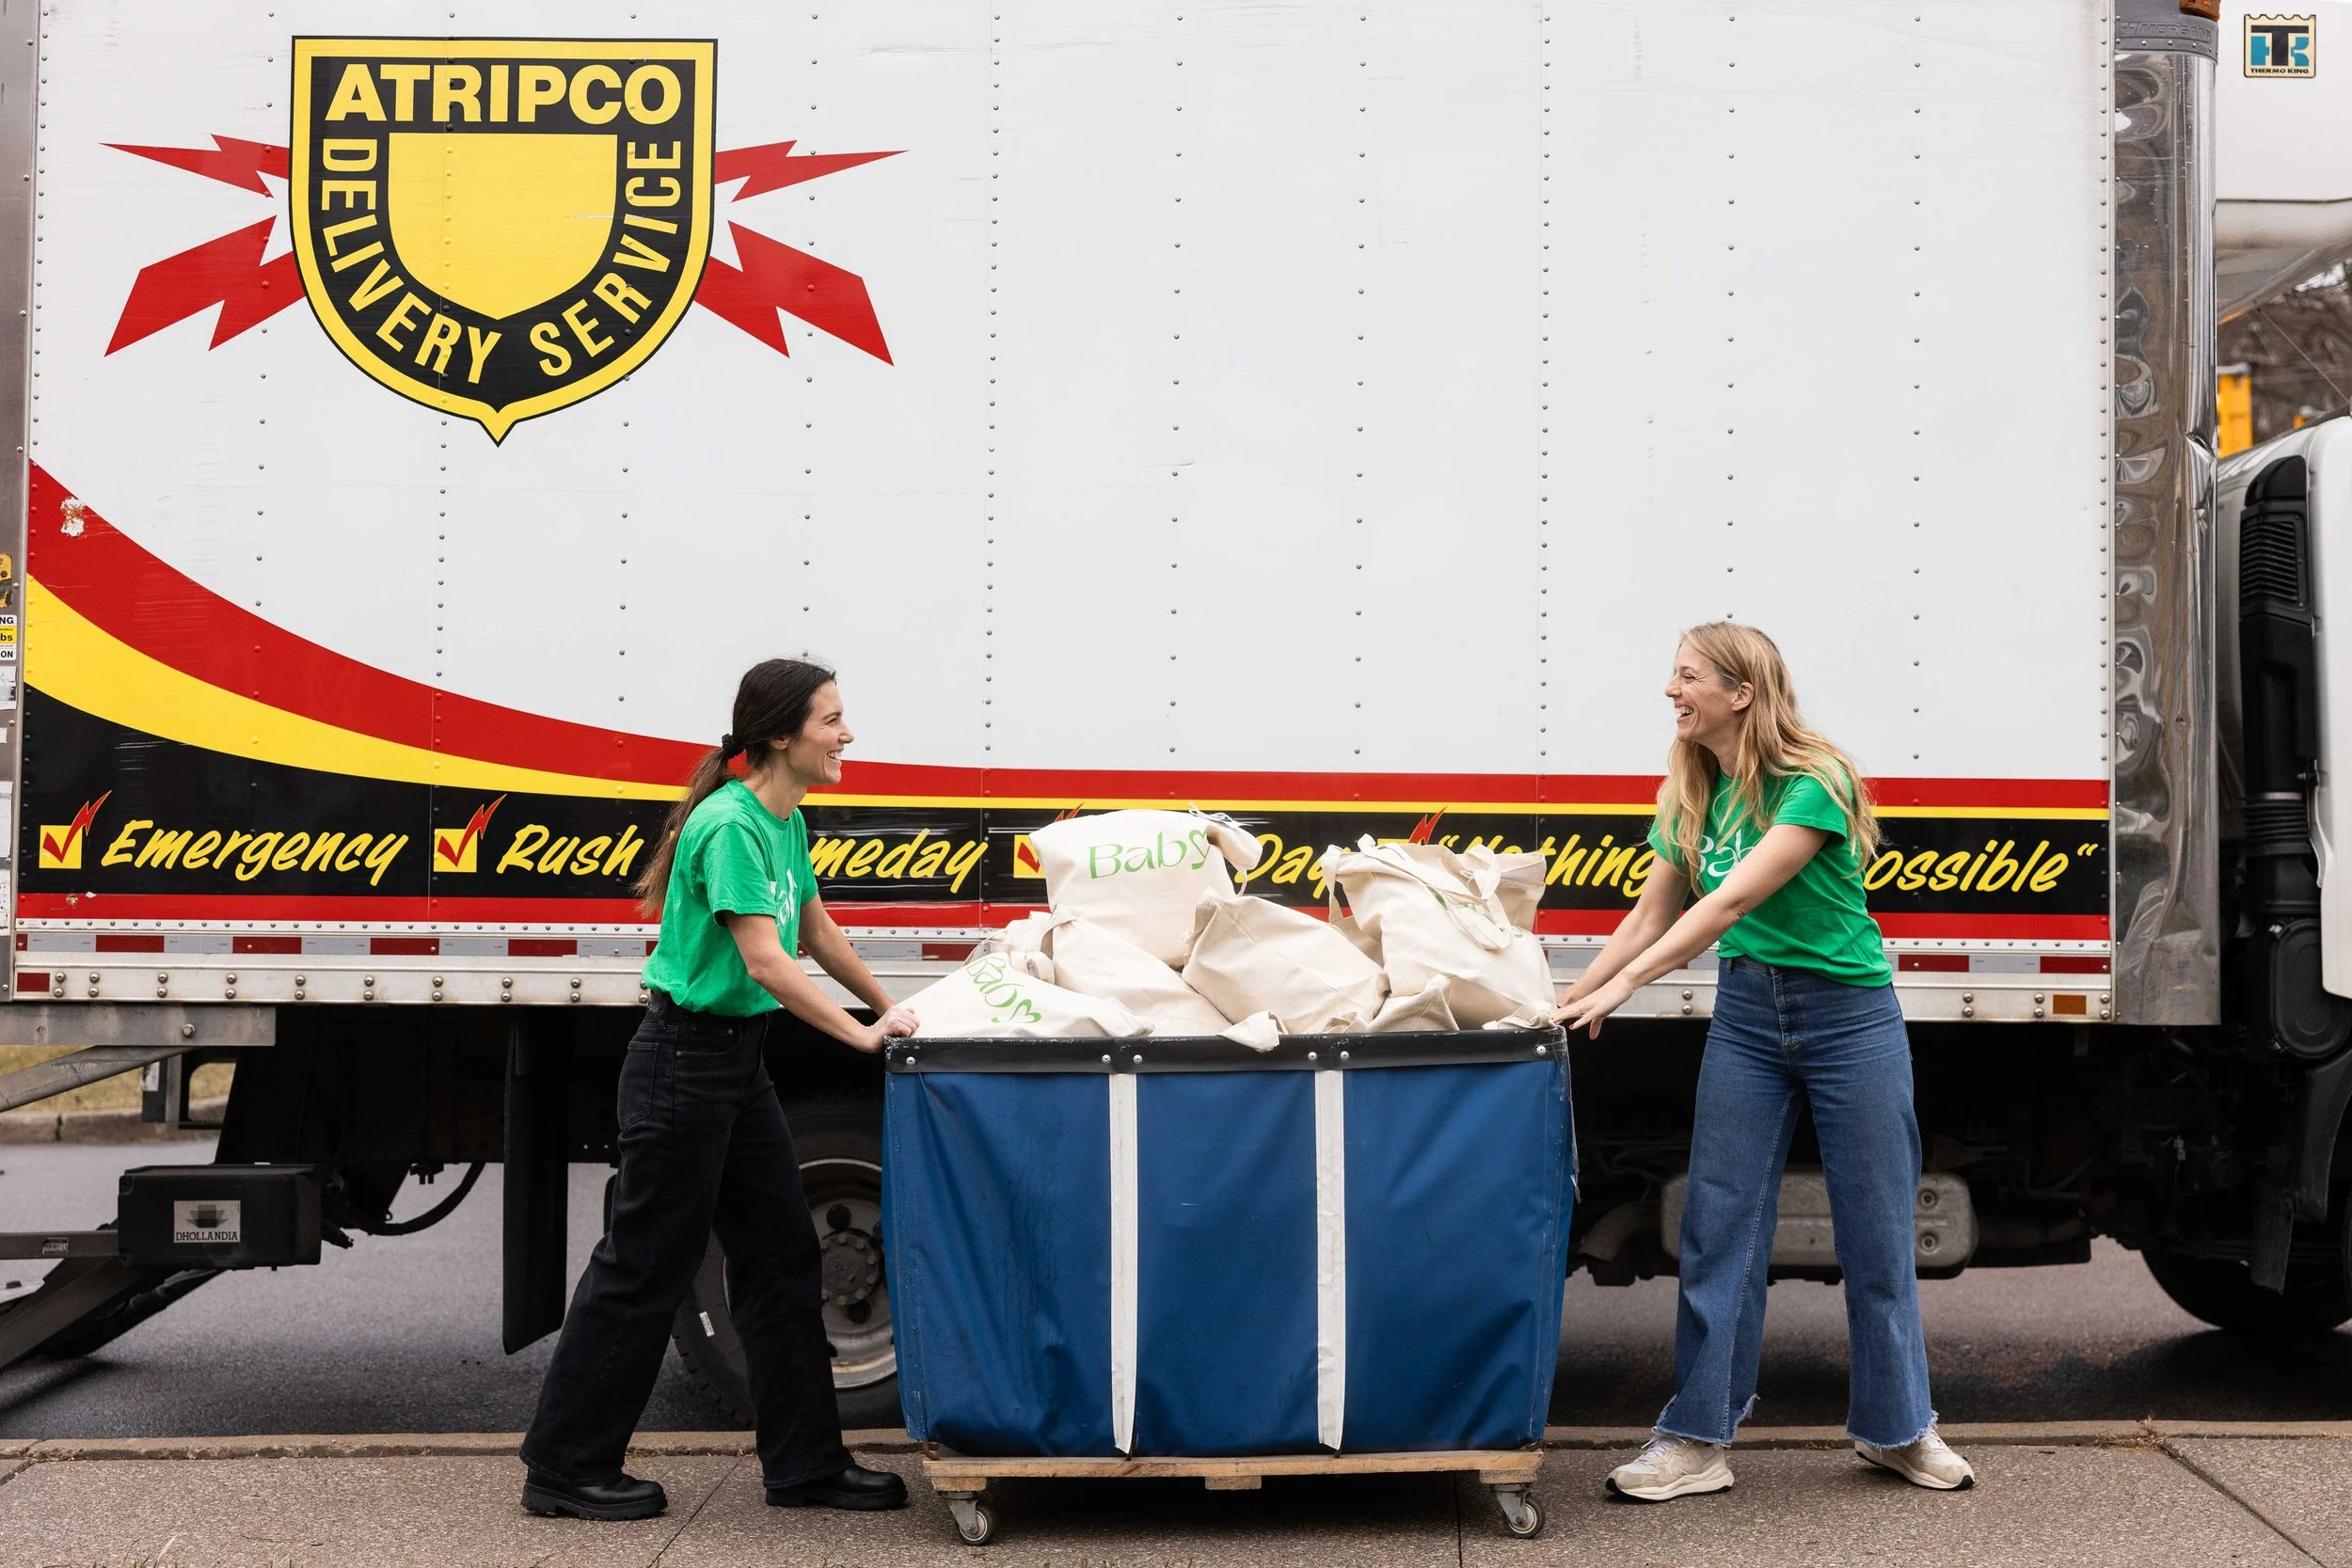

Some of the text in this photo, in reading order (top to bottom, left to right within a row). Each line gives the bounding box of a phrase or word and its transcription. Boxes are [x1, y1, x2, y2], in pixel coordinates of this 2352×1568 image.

[325, 63, 681, 125] ATRIPCO
[321, 137, 682, 385] DELIVERY SERVICE
[0, 616, 14, 625] NG
[0, 633, 13, 641] bs
[0, 650, 13, 658] ON
[101, 818, 409, 886] Emergency
[496, 823, 645, 877] Rush
[809, 827, 989, 895] meday
[175, 1231, 238, 1242] DHOLLANDIA
